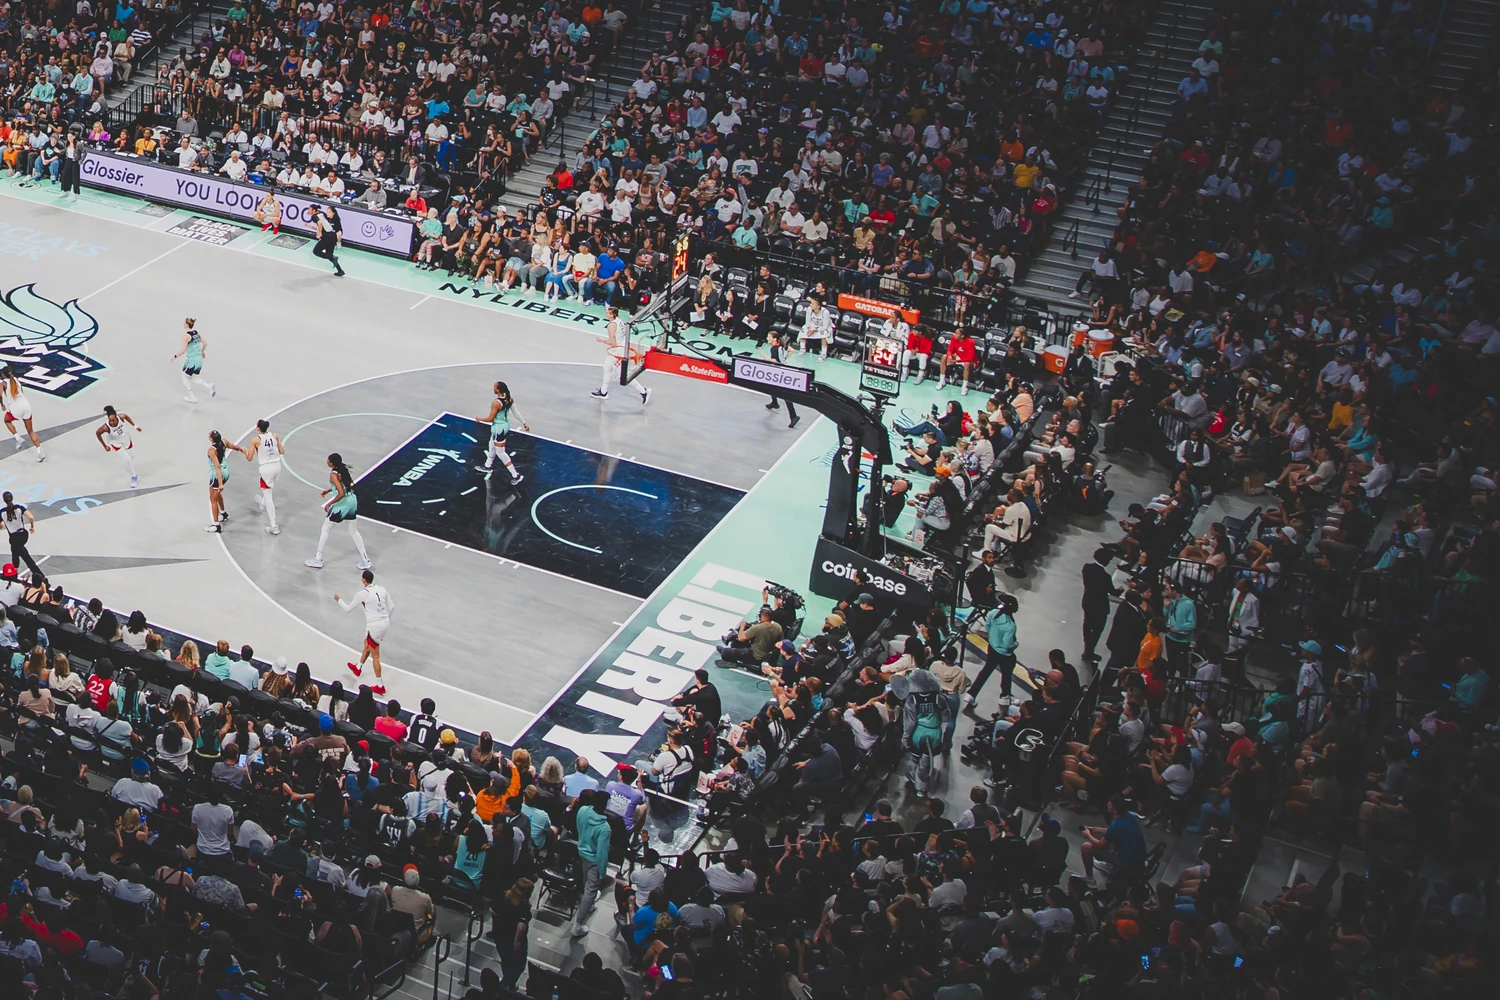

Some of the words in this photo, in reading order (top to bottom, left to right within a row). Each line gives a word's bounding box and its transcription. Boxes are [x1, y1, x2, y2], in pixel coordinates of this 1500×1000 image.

[82, 158, 144, 188] Glossier.
[175, 178, 210, 201] YOU
[190, 222, 228, 238] LIVES
[192, 216, 240, 234] BLACK
[169, 226, 229, 246] MATTER
[673, 253, 687, 280] 24
[740, 363, 801, 388] Glossier.
[264, 438, 273, 448] 41
[392, 453, 446, 488] WNBA
[542, 562, 771, 778] LIBERTY
[89, 680, 105, 696] 22
[418, 727, 426, 744] 0
[386, 826, 401, 841] 44
